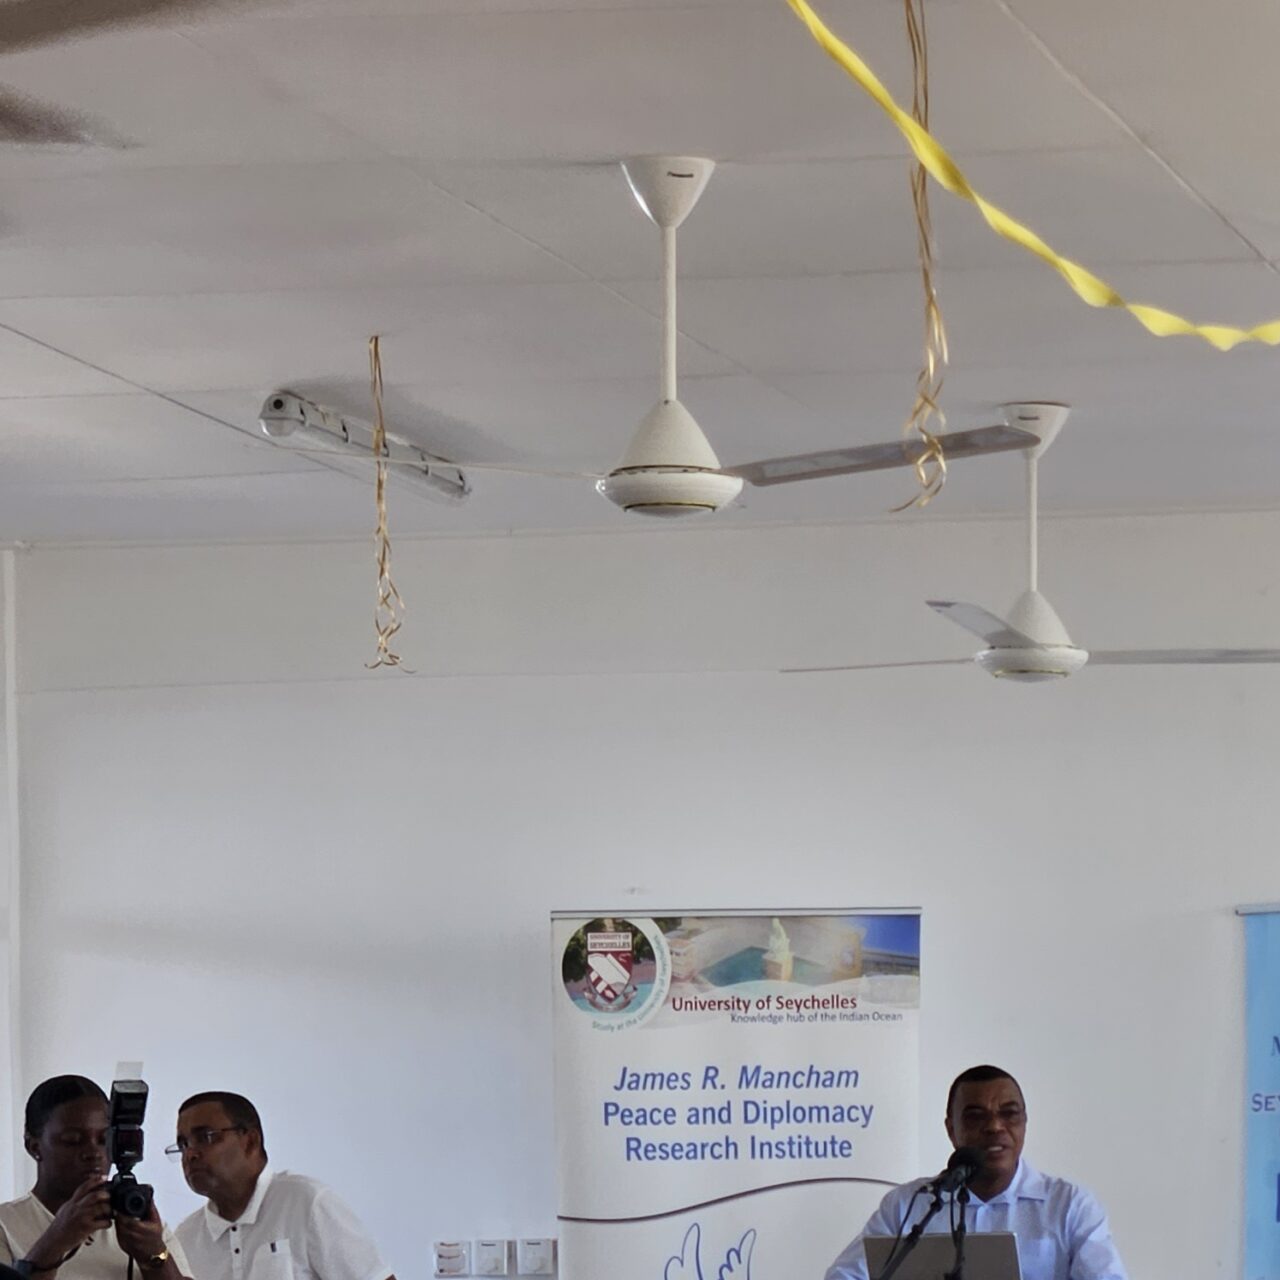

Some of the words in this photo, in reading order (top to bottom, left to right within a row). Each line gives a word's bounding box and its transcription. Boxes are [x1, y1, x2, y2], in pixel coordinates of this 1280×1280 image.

[672, 996, 751, 1013] University
[755, 995, 772, 1010] of
[776, 994, 857, 1012] Seychelles
[730, 1013, 784, 1025] Knowledge
[786, 1012, 805, 1022] hub
[807, 1012, 818, 1022] of
[820, 1012, 836, 1022] the
[839, 1012, 869, 1021] Indian
[872, 1012, 902, 1021] Ocean
[613, 1066, 691, 1091] James
[701, 1065, 726, 1090] R.
[738, 1064, 859, 1090] Mancham
[603, 1102, 677, 1126] Peace
[687, 1101, 732, 1125] and
[743, 1100, 874, 1130] Diplomacy
[626, 1136, 739, 1161] Research
[751, 1135, 853, 1160] Institute
